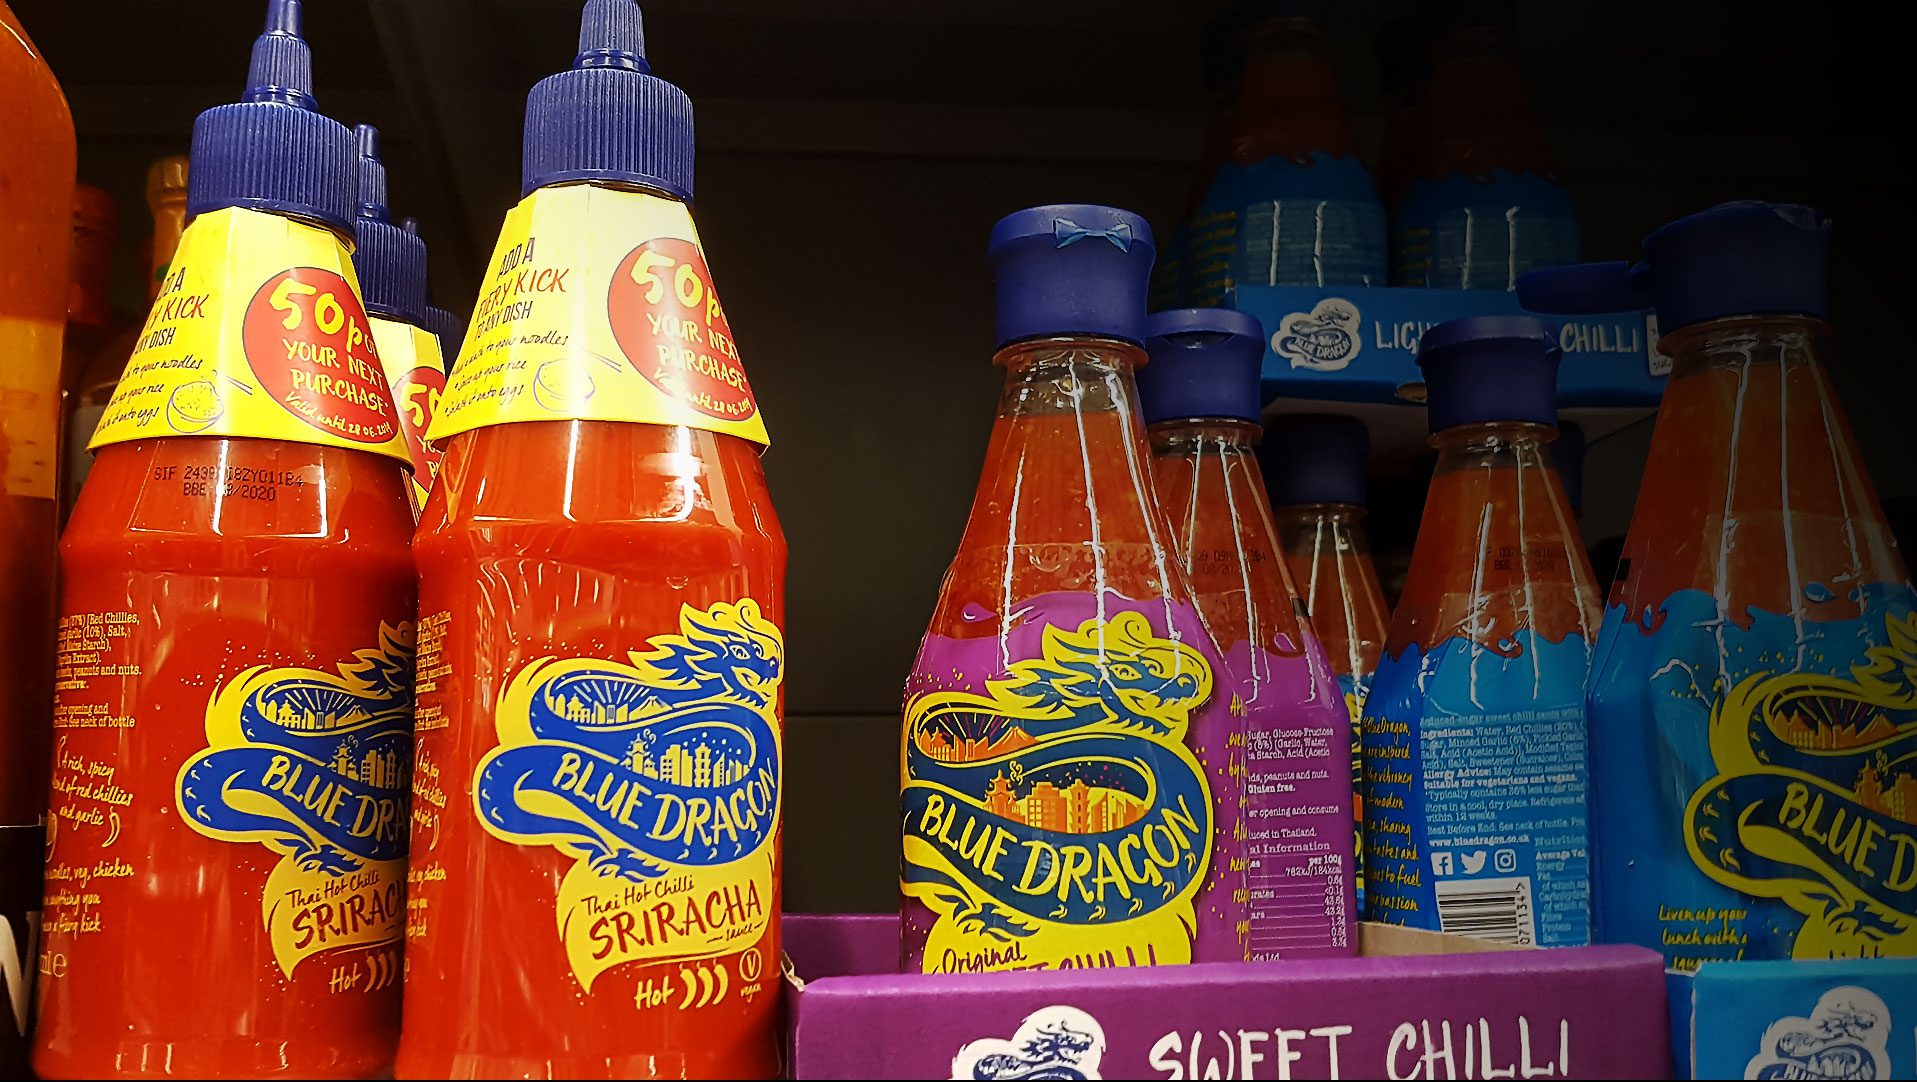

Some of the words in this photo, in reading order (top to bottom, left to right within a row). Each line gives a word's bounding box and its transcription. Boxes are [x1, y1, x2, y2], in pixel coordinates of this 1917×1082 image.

[497, 243, 522, 281] ADD
[522, 237, 536, 265] A
[172, 266, 187, 293] A
[514, 268, 570, 296] KICK
[162, 294, 210, 323] KICK
[502, 300, 534, 325] DISH
[149, 327, 176, 349] DISH
[520, 330, 569, 347] noodles
[646, 312, 703, 344] YOUR
[708, 328, 742, 366] NEXT
[1559, 322, 1639, 353] CHILLI
[161, 354, 203, 369] noodles
[282, 338, 341, 369] YOUR
[348, 355, 384, 392] NEXT
[498, 384, 525, 406] eggs
[284, 391, 317, 419] Valid
[317, 414, 347, 433] until
[154, 466, 178, 481] SIF
[183, 482, 207, 496] BBE
[105, 612, 140, 626] Chillies,
[107, 625, 128, 639] Salt,
[82, 638, 112, 652] Starch),
[72, 652, 101, 665] Extract).
[100, 664, 116, 676] and
[118, 664, 142, 676] nuts.
[94, 703, 109, 715] and
[108, 716, 136, 728] bottle
[1380, 715, 1411, 745] Dragon,
[1272, 727, 1334, 739] Glucose-Fructose
[1420, 728, 1473, 741] Ingredients:
[1449, 737, 1480, 748] Minced
[87, 761, 115, 787] spicy
[1264, 771, 1295, 783] peanuts
[1295, 770, 1310, 780] and
[1424, 770, 1454, 781] Allergy
[1457, 767, 1492, 778] Advice:
[1513, 763, 1544, 774] contain
[1276, 783, 1296, 793] free.
[1423, 779, 1459, 790] Suitable
[1461, 778, 1475, 788] for
[1477, 775, 1528, 788] vegetarians
[1529, 774, 1546, 784] and
[92, 784, 134, 808] chillies
[261, 754, 354, 828] BLUE
[346, 794, 409, 844] DRA
[551, 751, 653, 831] BLUE
[645, 756, 777, 848] DRAGON
[1470, 788, 1507, 797] contains
[1259, 806, 1292, 818] opening
[1291, 805, 1307, 816] and
[1307, 804, 1340, 815] consume
[1467, 801, 1488, 812] cool,
[1488, 799, 1505, 810] dry
[75, 807, 105, 831] garlic
[1426, 814, 1453, 823] within
[1281, 826, 1318, 838] Thailand.
[1379, 815, 1412, 846] sharing
[1447, 824, 1476, 835] Before
[1777, 781, 1887, 879] BLUE
[919, 793, 1019, 882] BLUE
[1011, 794, 1200, 904] DRAGON
[1263, 840, 1331, 853] Information
[1429, 833, 1530, 847] www.bluedragon.co.uk
[1400, 842, 1420, 861] and
[1536, 850, 1570, 861] Average
[92, 857, 134, 878] chicken
[1309, 856, 1323, 868] per
[1385, 864, 1396, 883] to
[1396, 863, 1422, 892] fuel
[285, 887, 323, 910] Thai
[323, 877, 349, 900] Hot
[348, 870, 381, 893] Chilli
[581, 894, 622, 917] Thai
[623, 886, 653, 908] Hot
[653, 874, 696, 900] Chilli
[1379, 894, 1420, 912] passion
[80, 912, 101, 933] kick
[588, 878, 764, 961] SRIRACHA
[1658, 903, 1695, 922] Liven
[1695, 906, 1716, 926] up
[725, 924, 753, 943] sauce
[1661, 927, 1702, 945] lunch
[942, 940, 1028, 974] Original
[328, 961, 362, 995] Hot
[633, 975, 676, 1011] Hot
[1386, 1015, 1569, 1081] CHILLI
